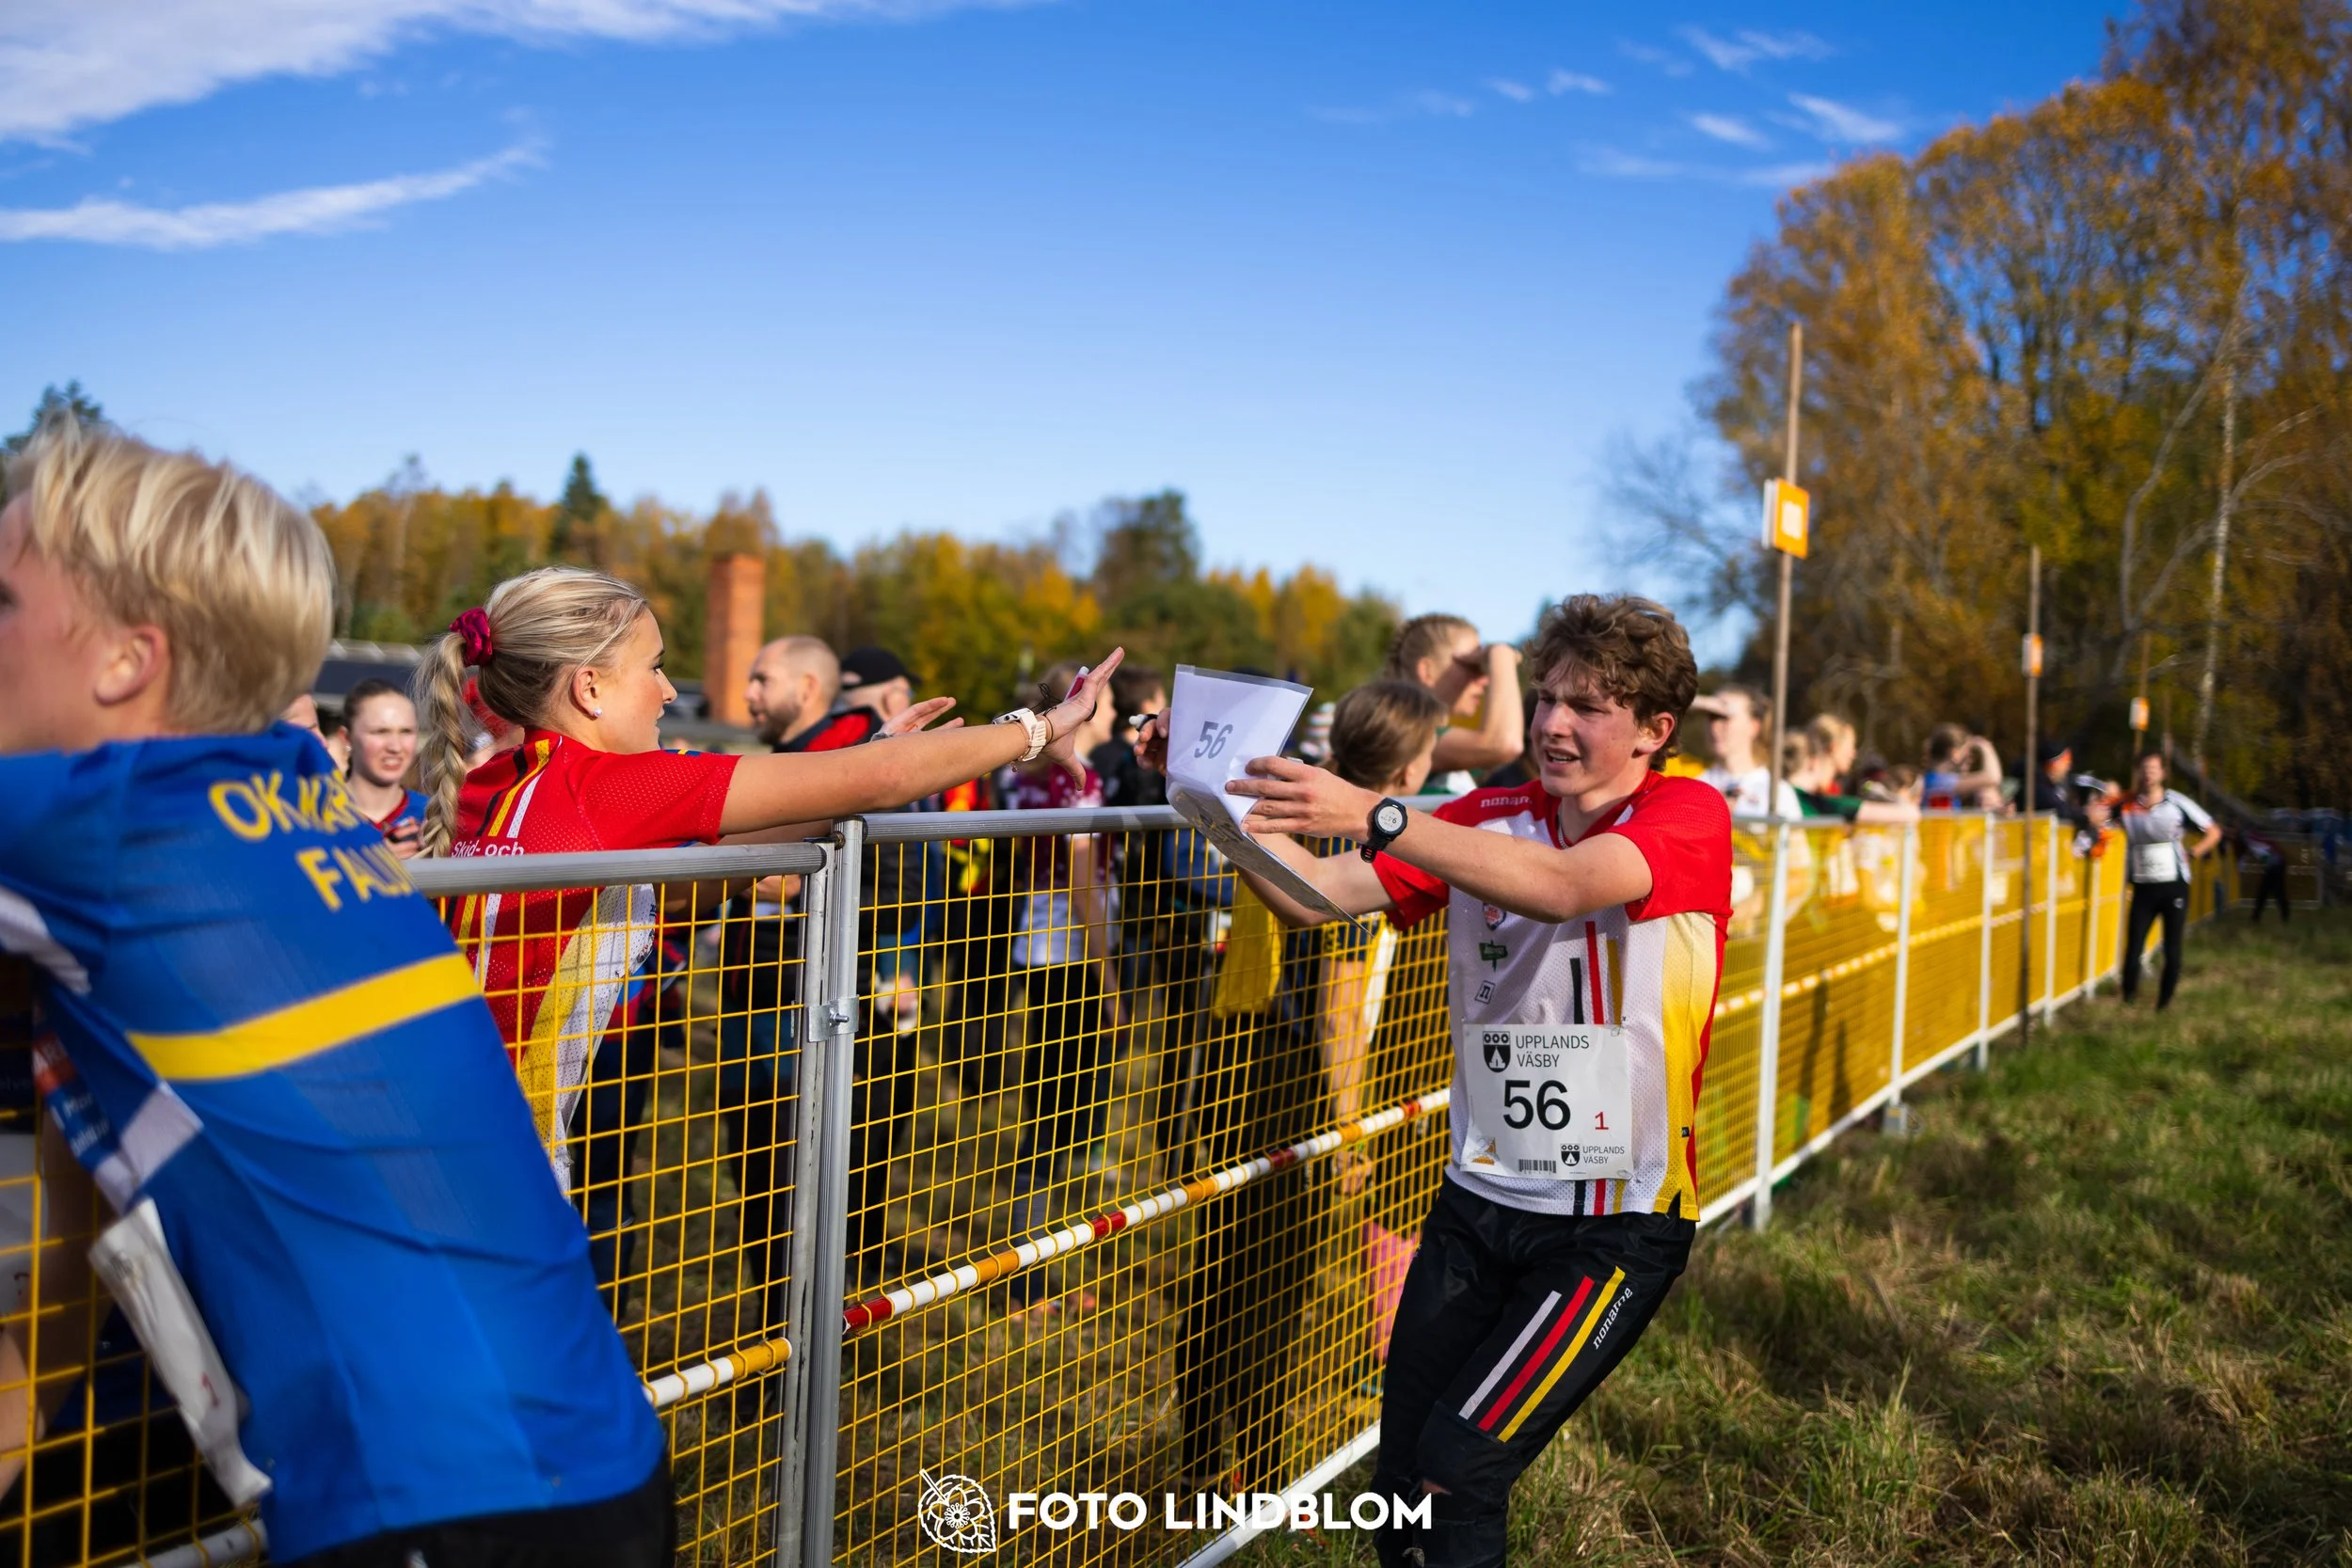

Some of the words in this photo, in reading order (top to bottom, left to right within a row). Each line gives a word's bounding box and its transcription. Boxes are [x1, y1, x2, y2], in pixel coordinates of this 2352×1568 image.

[1194, 721, 1233, 759] 56
[208, 768, 309, 841] OK
[485, 841, 525, 857] och
[1516, 1035, 1590, 1049] UPPLANDS
[1517, 1051, 1560, 1068] VÄSBY
[1502, 1079, 1571, 1131] 56
[1595, 1111, 1610, 1131] 1
[1582, 1146, 1625, 1155] UPPLANDS
[1593, 1287, 1633, 1351] noname
